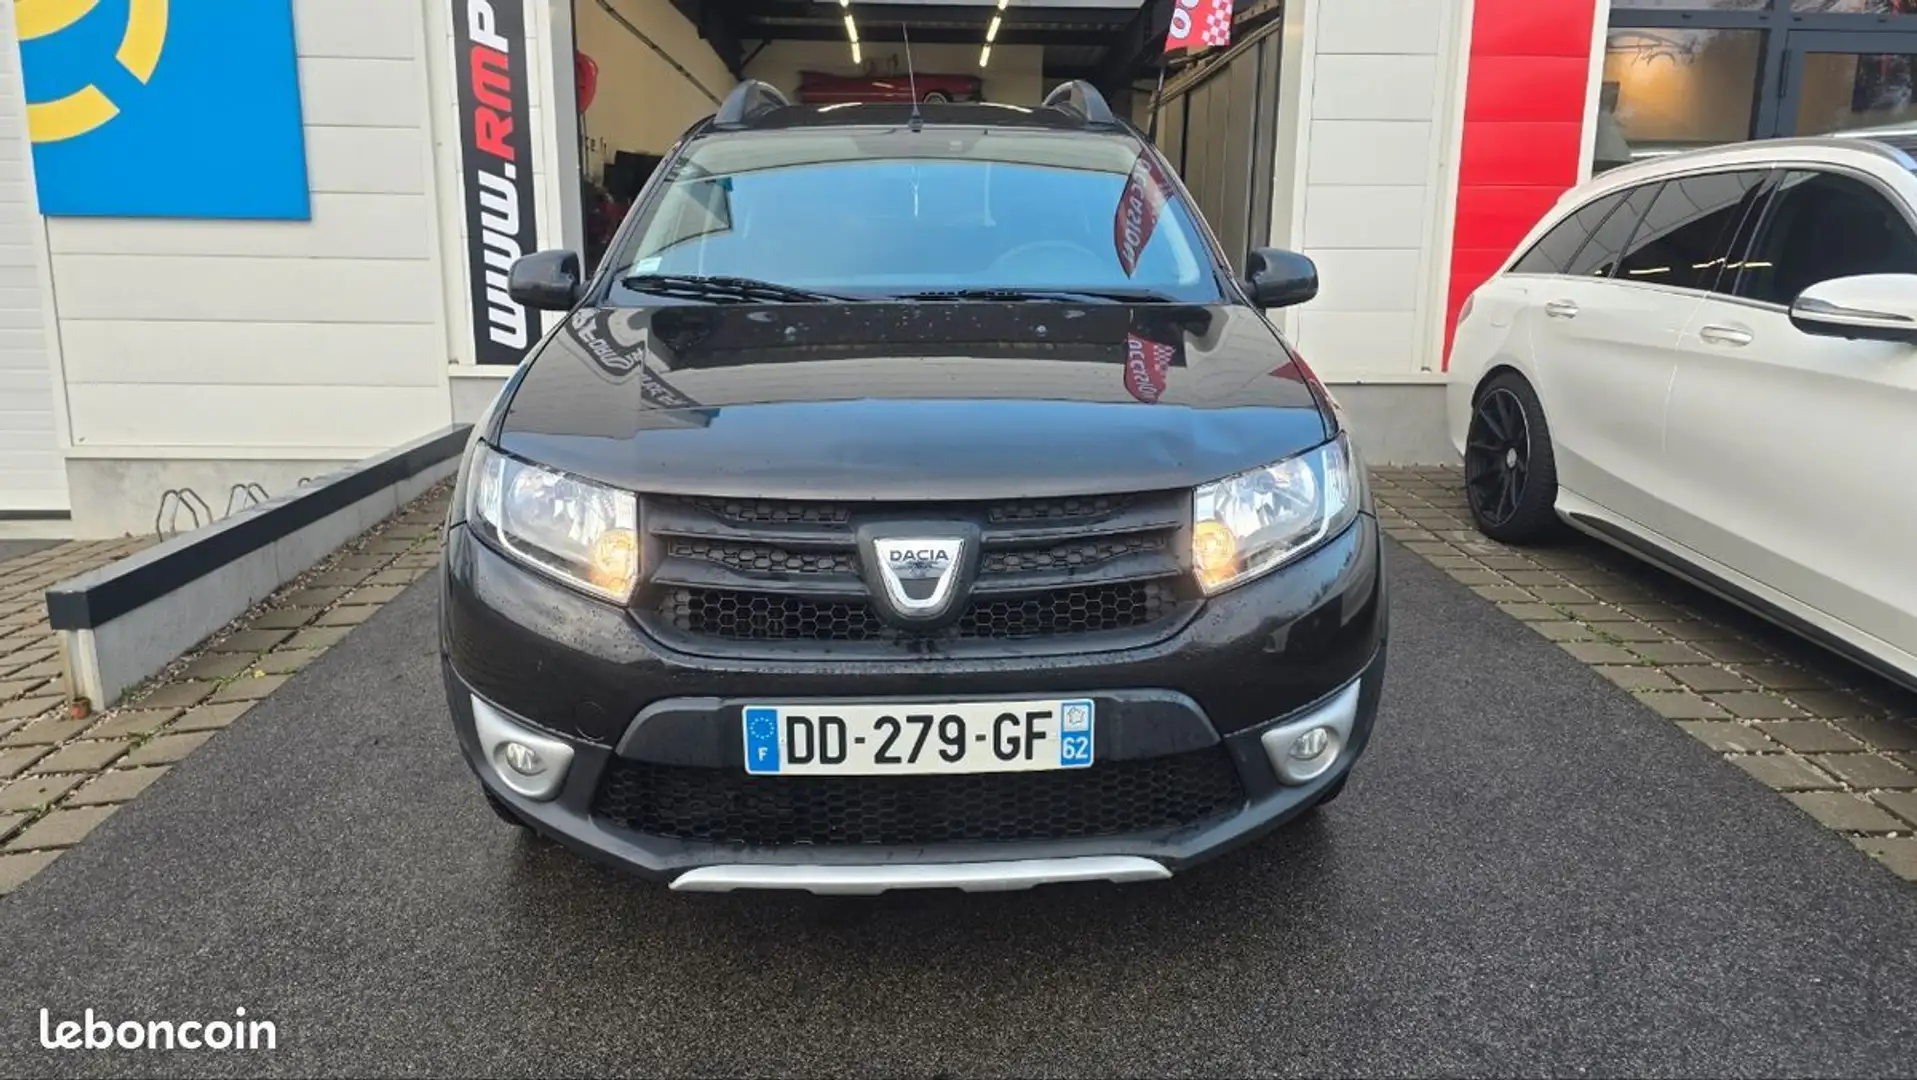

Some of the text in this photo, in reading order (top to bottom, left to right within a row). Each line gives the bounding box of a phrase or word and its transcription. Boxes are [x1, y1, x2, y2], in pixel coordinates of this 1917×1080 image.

[889, 549, 949, 561] DACIA
[786, 711, 1053, 764] DD-279-GF
[757, 746, 768, 761] F
[1062, 736, 1089, 760] 62
